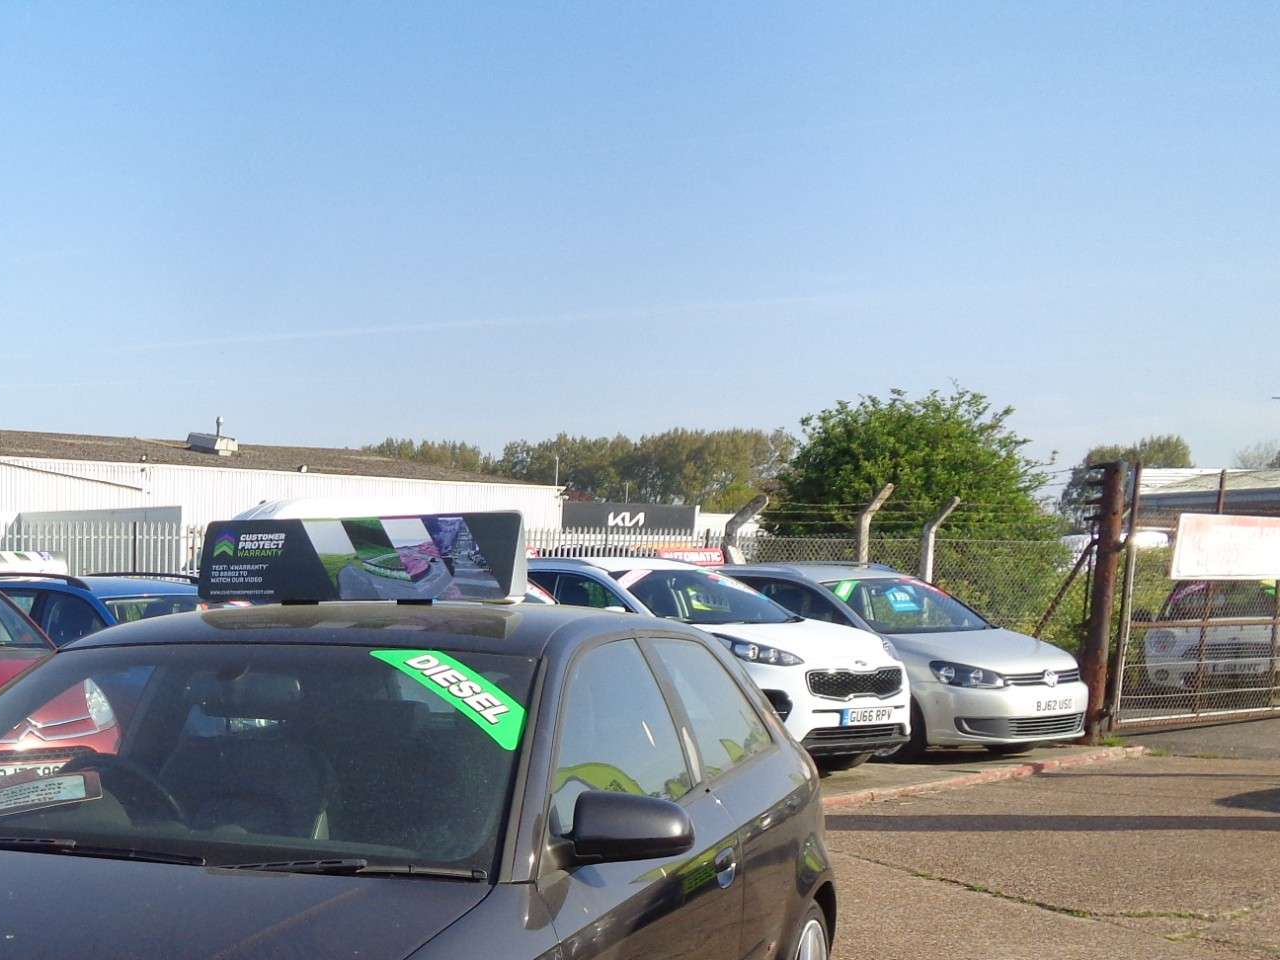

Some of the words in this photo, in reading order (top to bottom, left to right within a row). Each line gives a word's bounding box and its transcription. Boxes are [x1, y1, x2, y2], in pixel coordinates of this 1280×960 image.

[608, 511, 645, 527] KIA
[240, 532, 286, 541] CUSTOMER
[238, 540, 285, 549] PROTECT
[237, 549, 284, 558] WARRANTY
[403, 654, 511, 725] DIESEL
[849, 710, 874, 723] GU66
[875, 708, 893, 721] RPV
